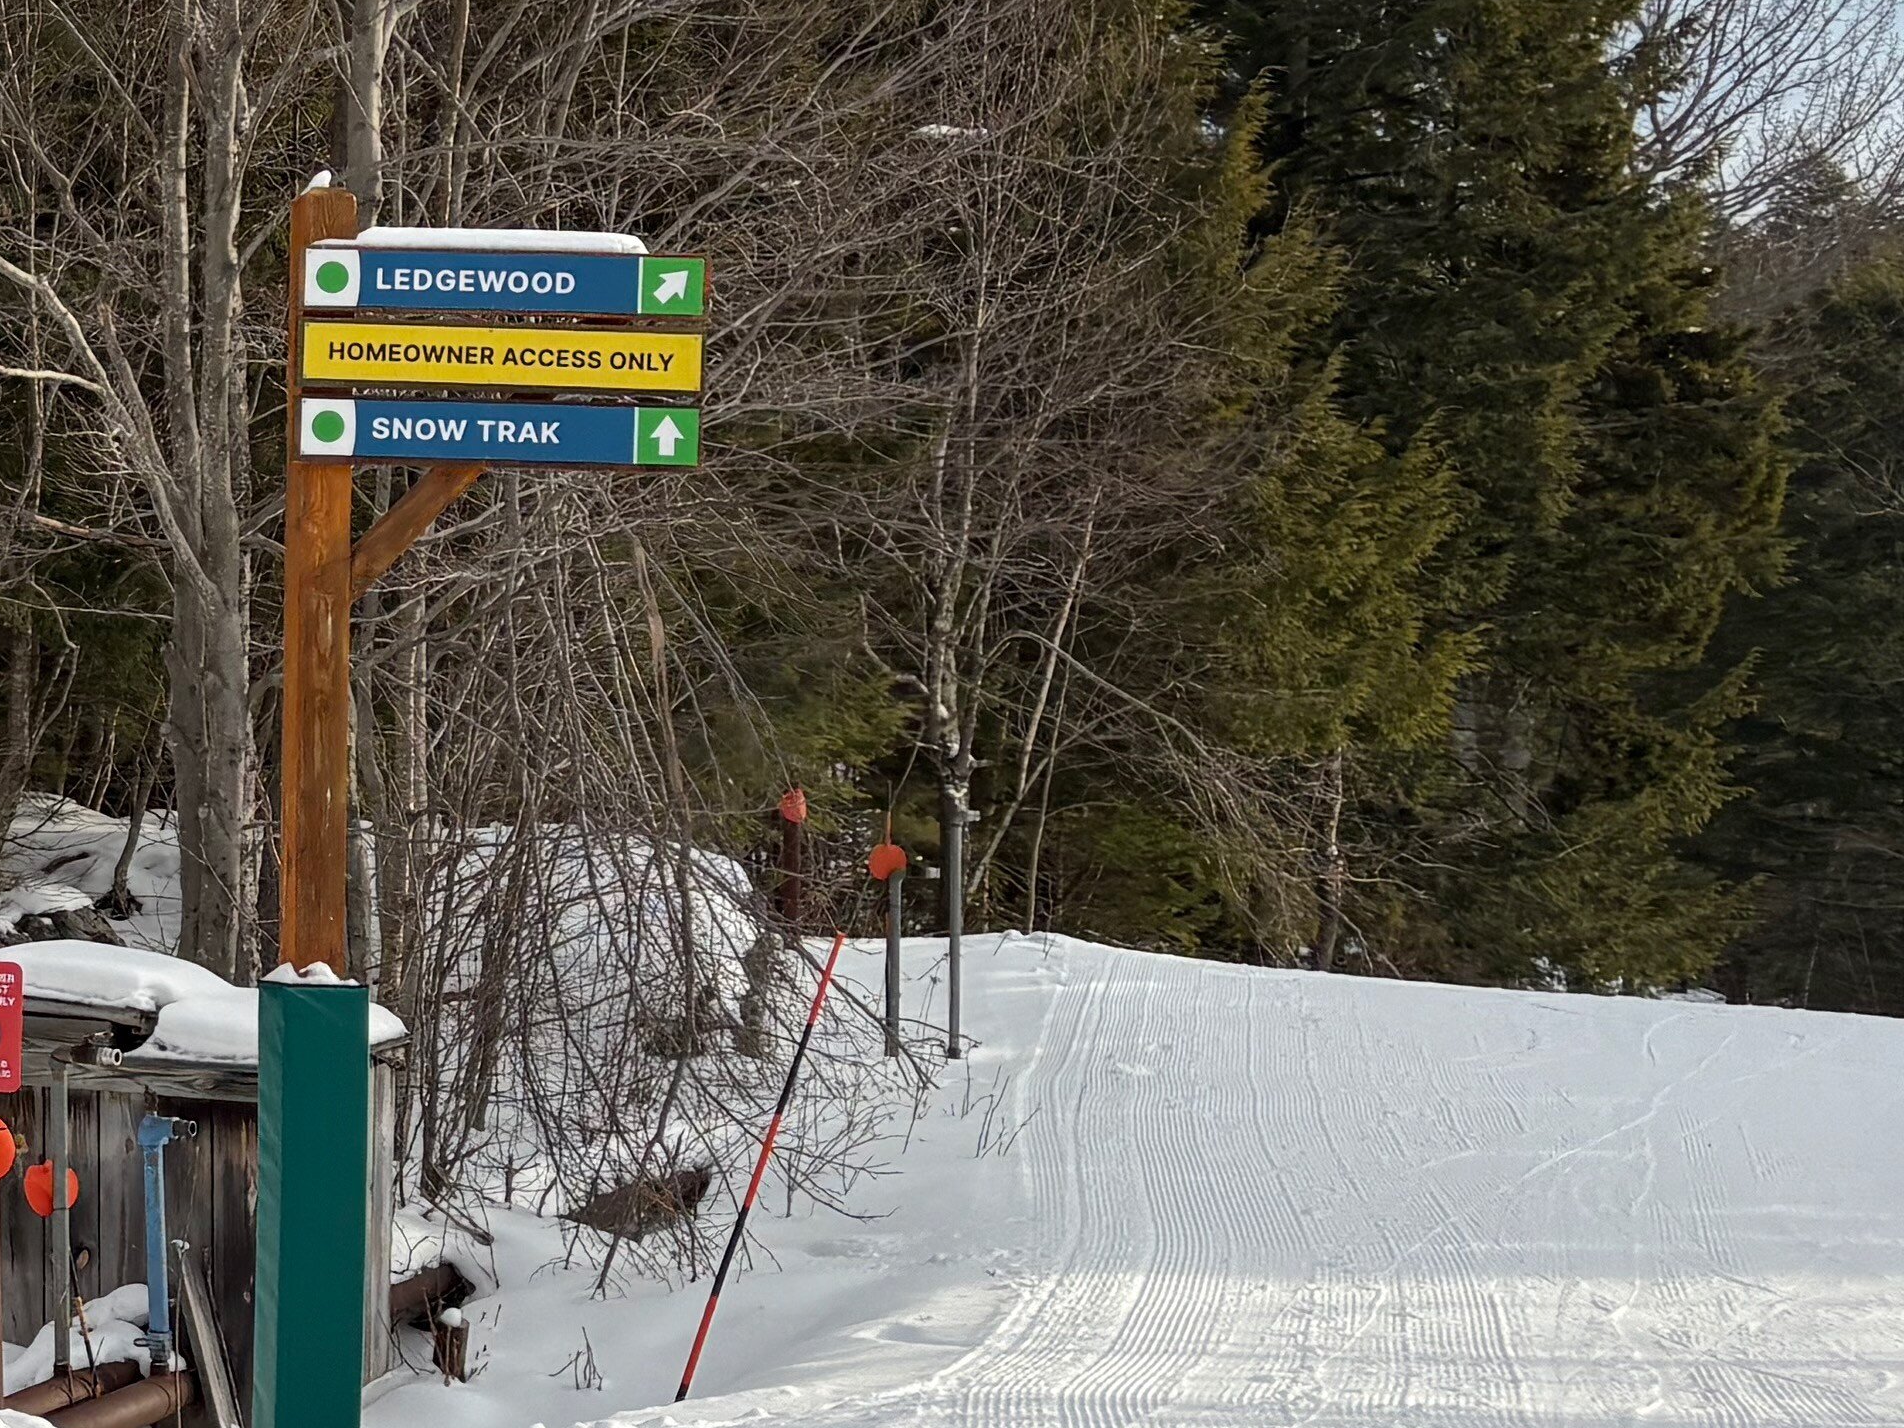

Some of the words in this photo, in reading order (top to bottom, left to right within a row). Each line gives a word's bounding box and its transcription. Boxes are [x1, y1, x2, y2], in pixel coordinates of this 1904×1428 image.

[375, 267, 576, 295] LEDGEWOOD
[328, 341, 494, 366] HOMEOWNER
[502, 347, 602, 370] ACCESS
[609, 352, 675, 372] ONLY
[371, 417, 468, 441] SNOW
[477, 419, 561, 445] TRAK
